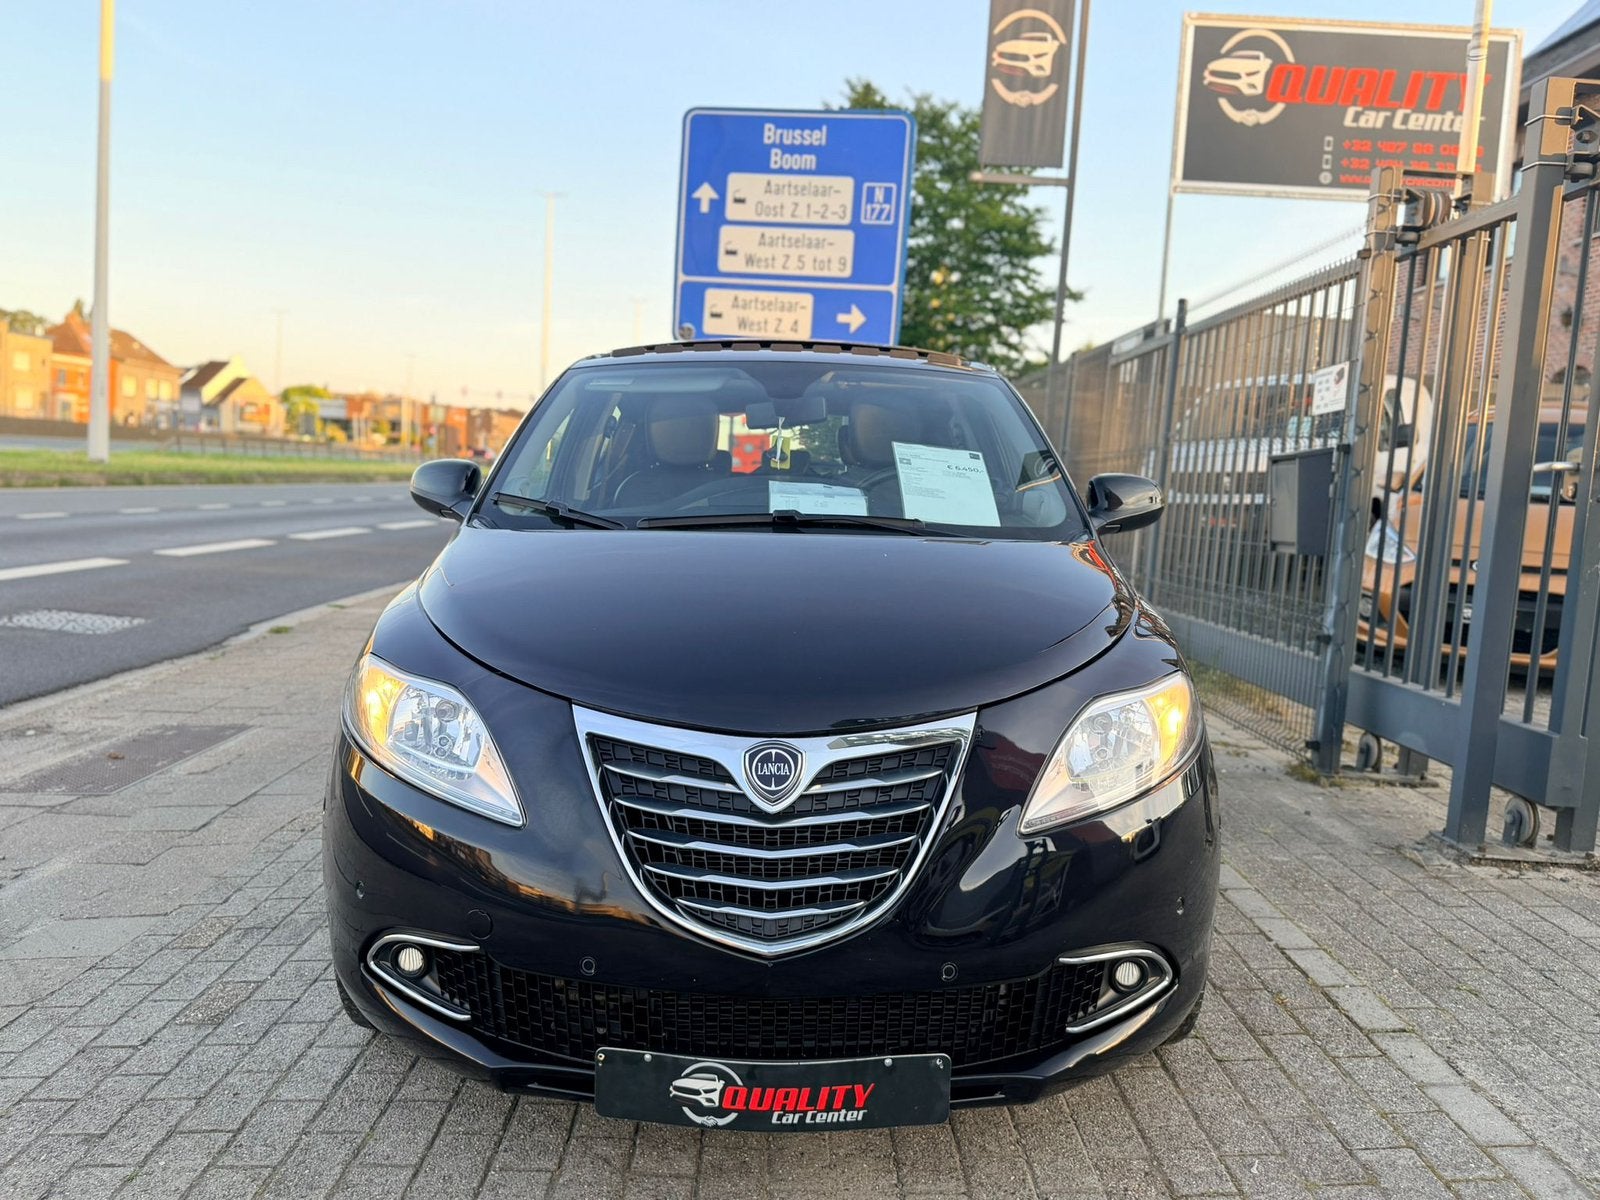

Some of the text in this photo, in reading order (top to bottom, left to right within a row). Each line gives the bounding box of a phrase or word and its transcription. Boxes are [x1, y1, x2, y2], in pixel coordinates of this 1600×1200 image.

[1343, 106, 1486, 132] Car Cente
[763, 123, 827, 146] Brussel
[769, 148, 816, 170] Boom
[764, 179, 841, 197] Aartselaar-
[874, 186, 885, 203] N
[754, 201, 785, 218] Oost
[866, 203, 891, 221] 177
[758, 232, 835, 250] Aartselaar-
[744, 252, 776, 270] West
[812, 256, 832, 272] tot
[838, 256, 847, 273] 9
[731, 294, 806, 313] Aartselaar-
[737, 315, 768, 333] West
[757, 763, 790, 775] LANCIA
[722, 1083, 875, 1113] QUALITY
[771, 1108, 868, 1124] Car Center
